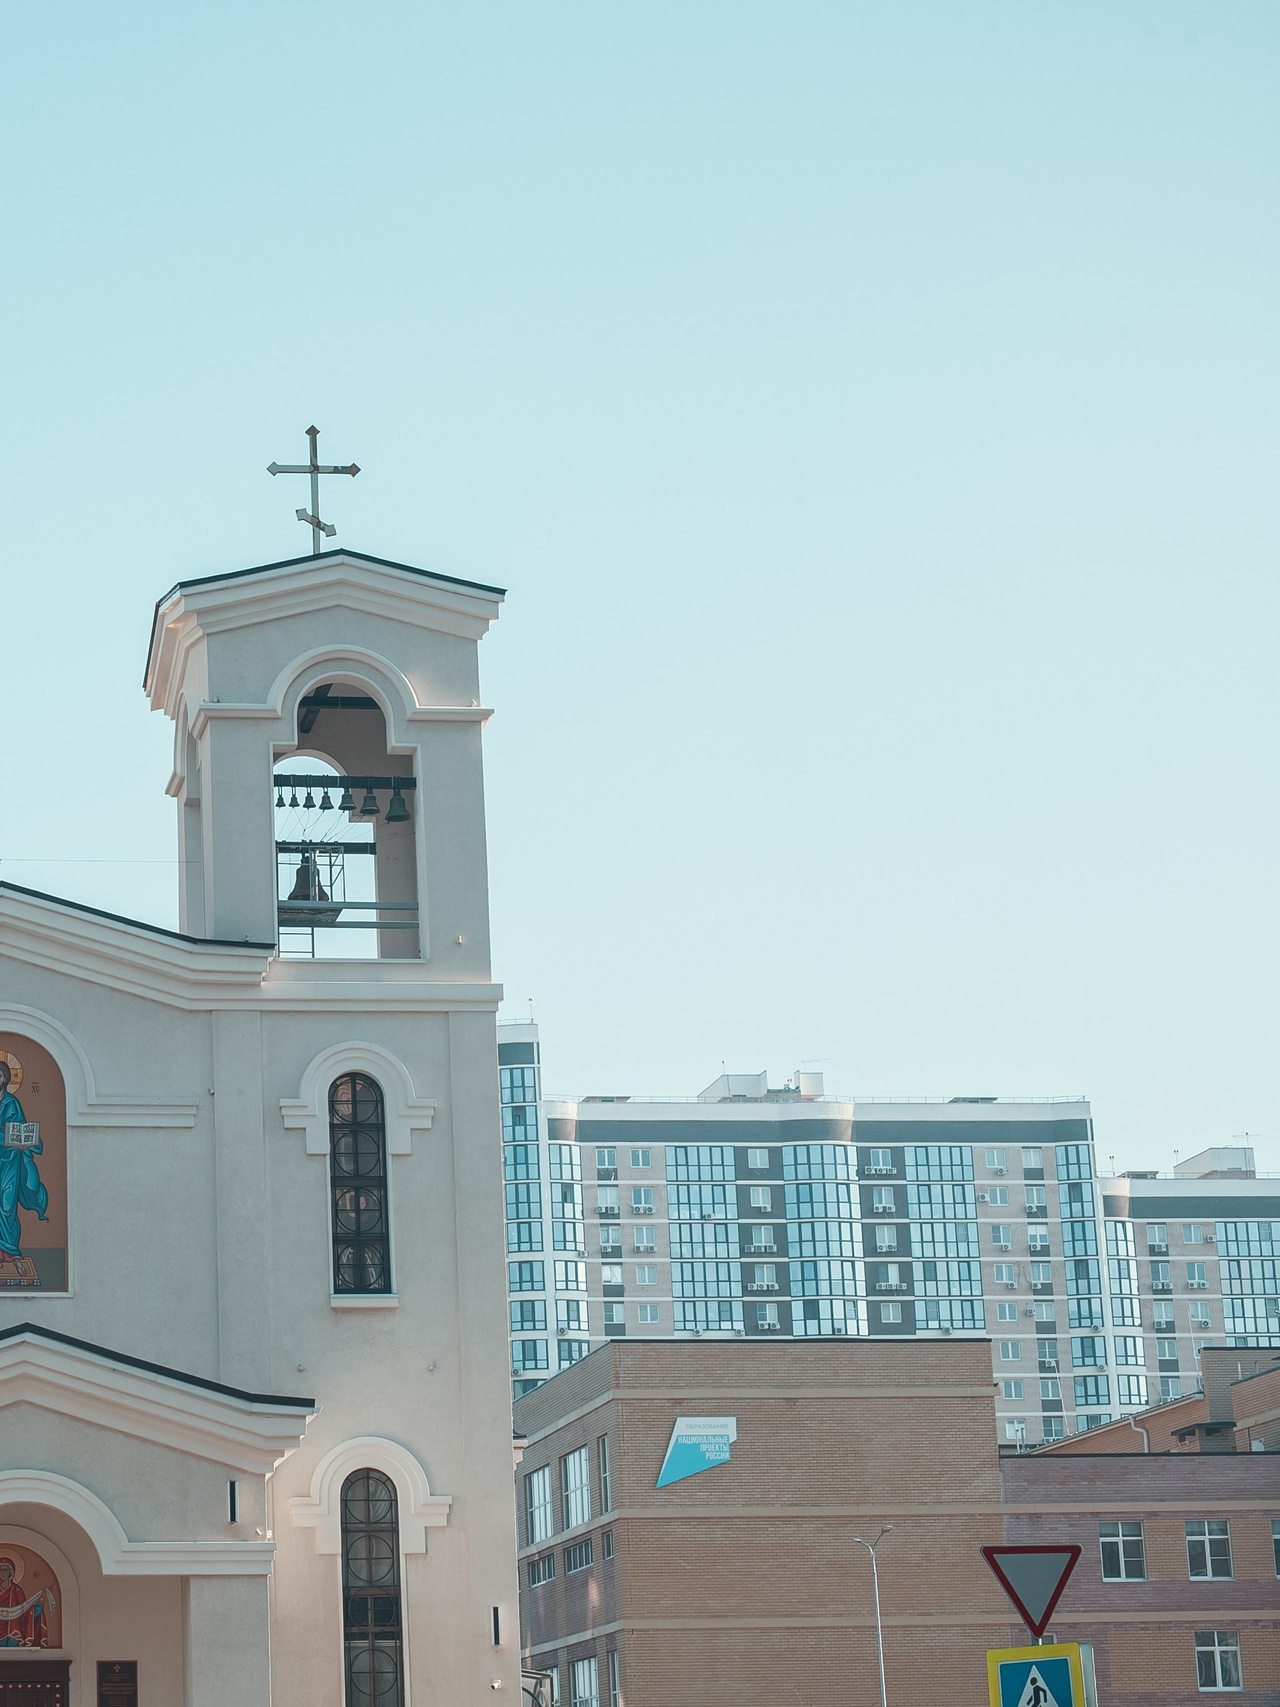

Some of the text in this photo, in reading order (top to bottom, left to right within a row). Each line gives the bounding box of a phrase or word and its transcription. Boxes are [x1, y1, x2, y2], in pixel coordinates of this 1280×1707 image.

[677, 1435, 729, 1444] НАЦИОНАЛЬНЫЕ
[700, 1444, 729, 1452] ПРОЕКТЫ
[705, 1452, 730, 1460] РОССИИ
